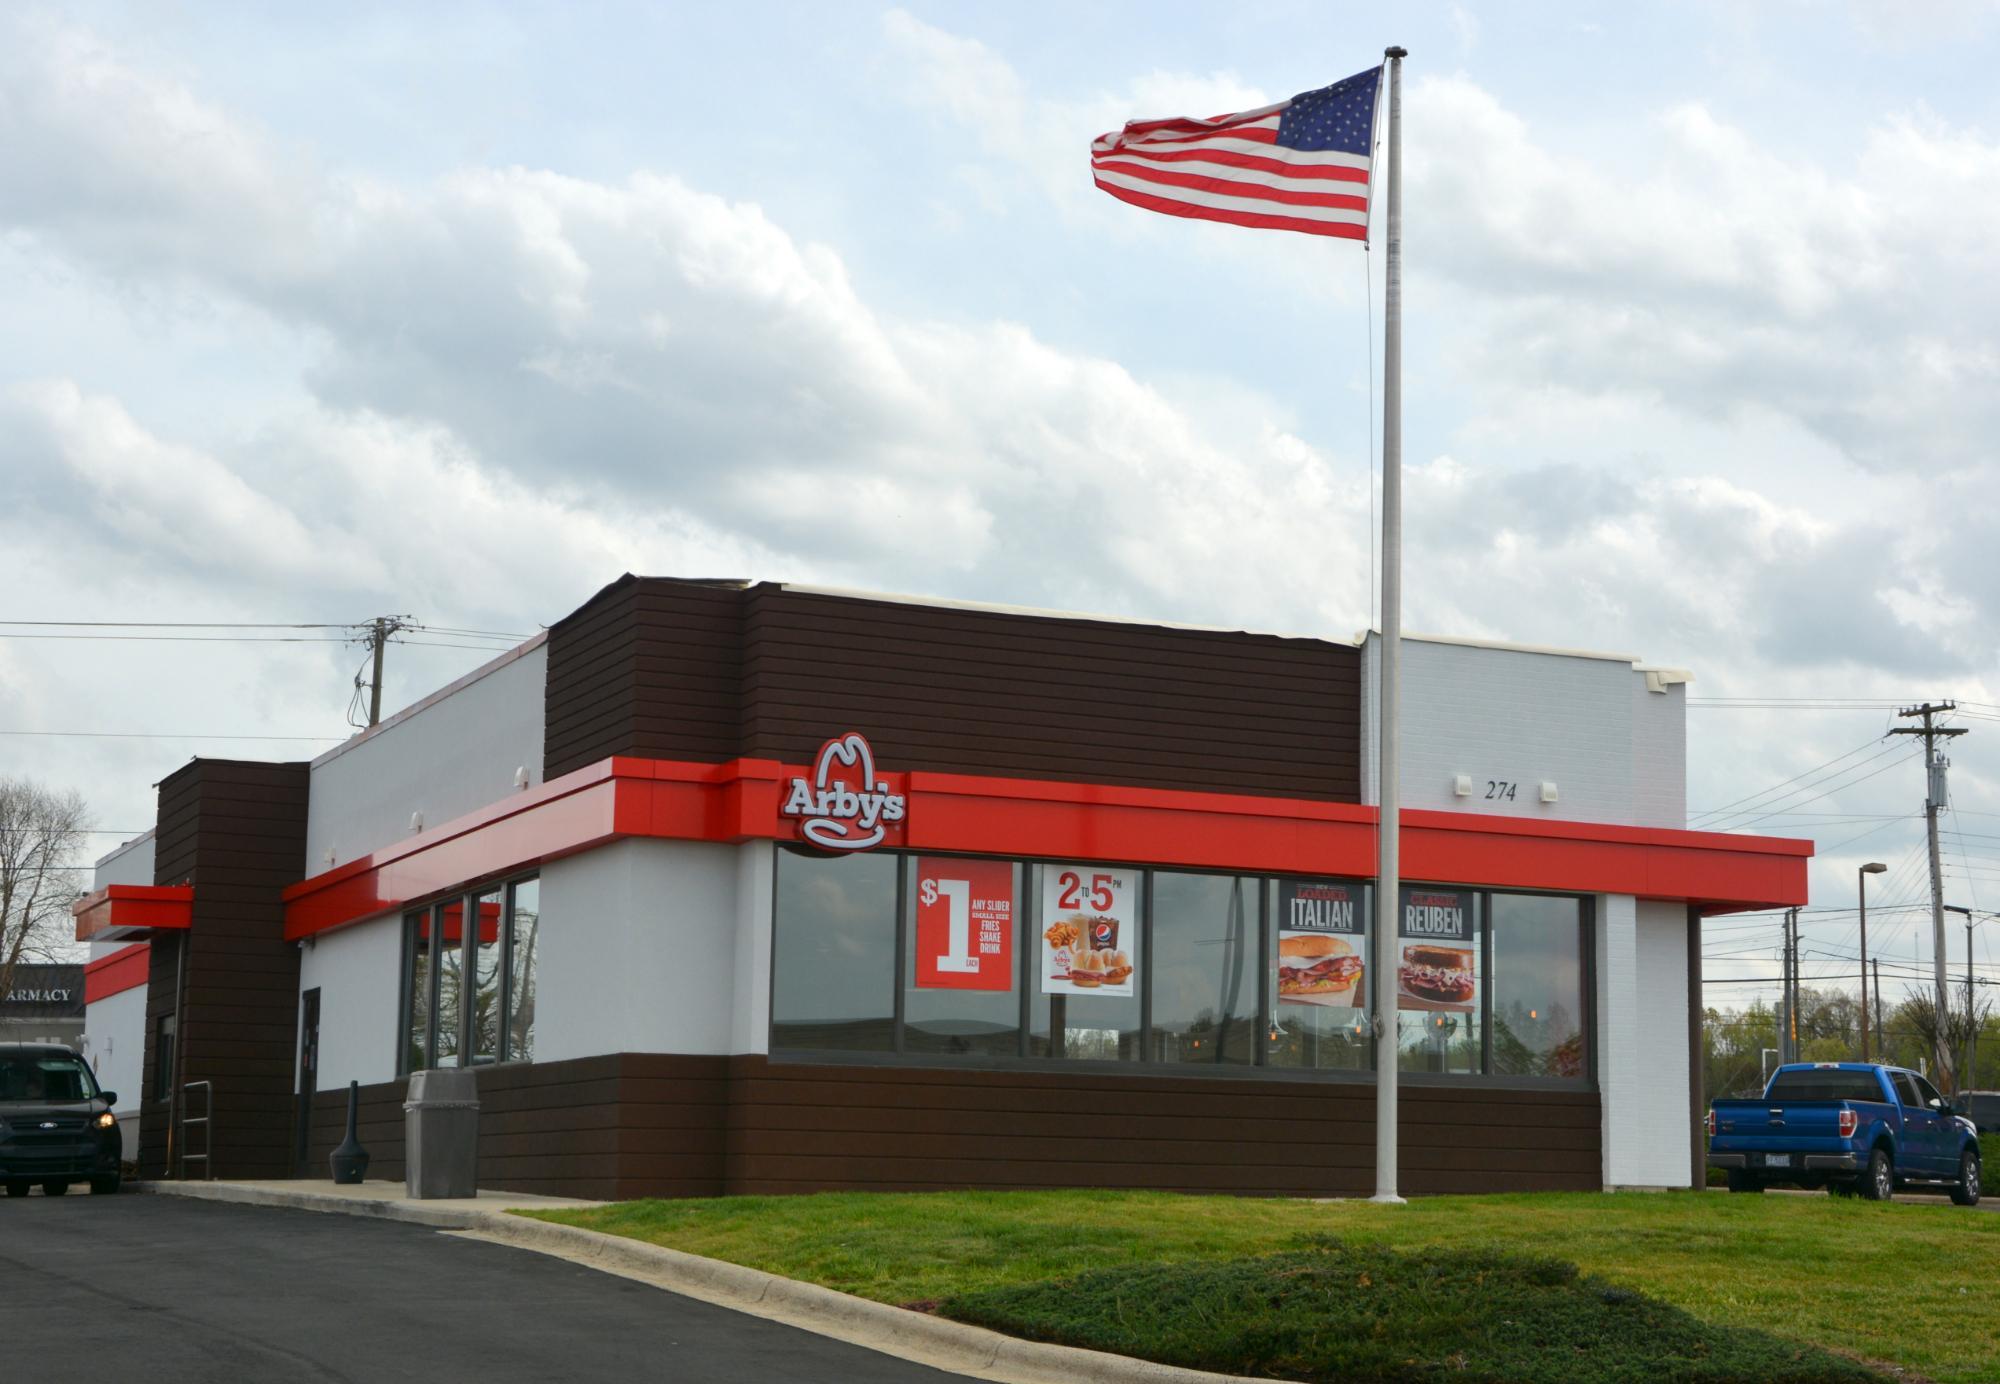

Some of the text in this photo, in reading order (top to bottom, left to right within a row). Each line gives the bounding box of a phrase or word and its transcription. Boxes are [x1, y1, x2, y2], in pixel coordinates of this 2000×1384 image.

[1485, 780, 1517, 801] 274
[784, 778, 904, 829] Arby's
[1058, 871, 1122, 912] 2 TO 5 PM
[972, 899, 1010, 912] ANY SLIDER
[1291, 898, 1353, 928] ITALIAN
[920, 878, 979, 973] $1
[981, 920, 1000, 931] FRIES
[1406, 905, 1463, 934] REUBEN
[979, 931, 1001, 943] SHAKE
[980, 943, 1001, 954] DRINK
[965, 958, 979, 968] EACH
[5, 988, 71, 1001] ARMACY
